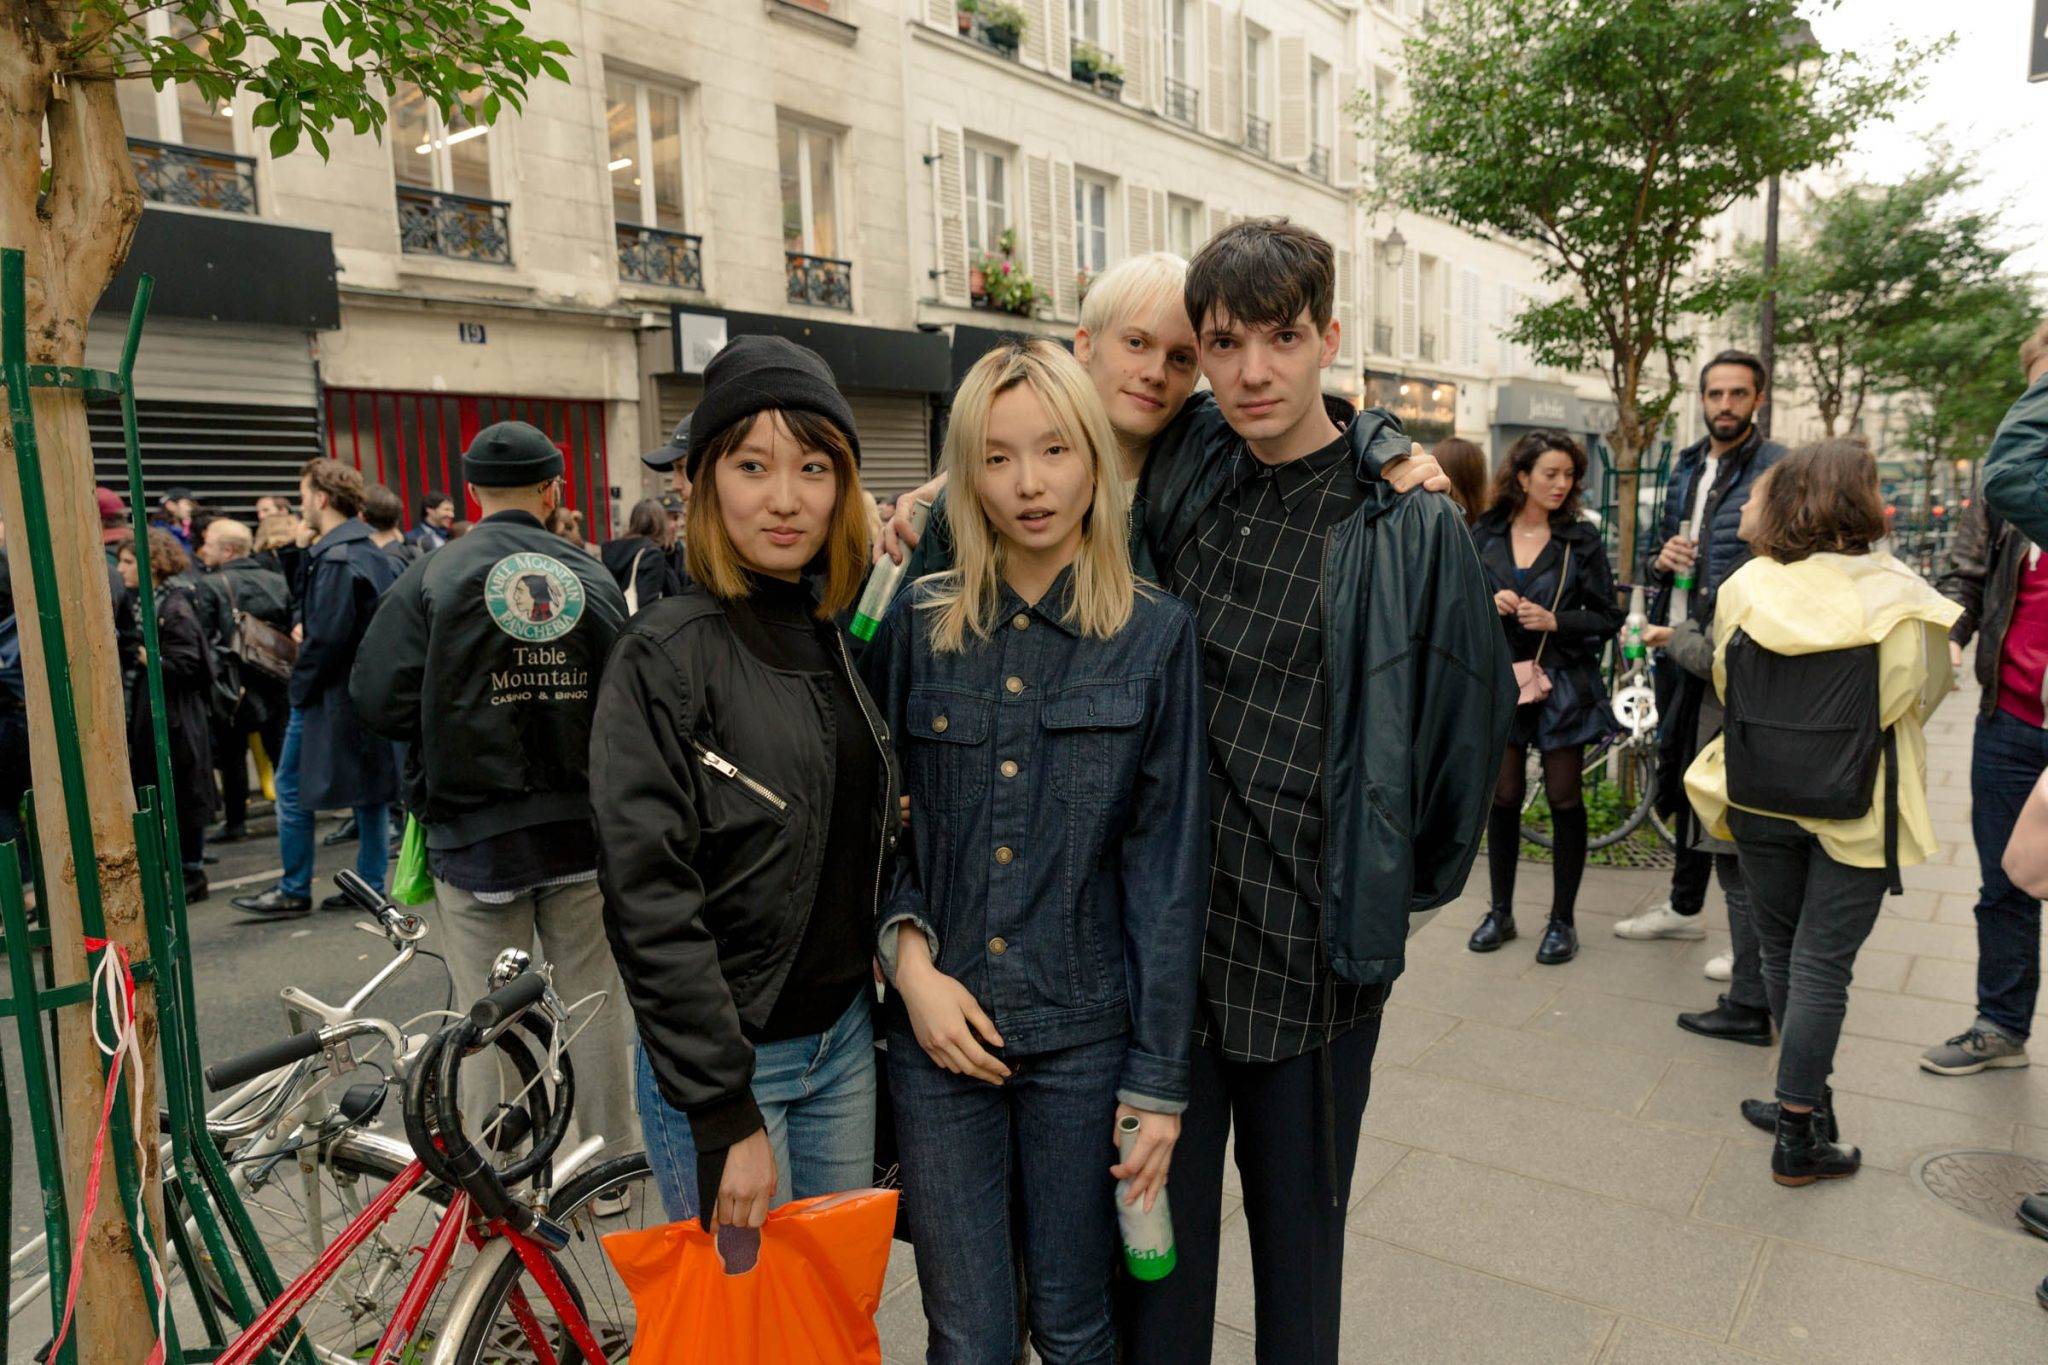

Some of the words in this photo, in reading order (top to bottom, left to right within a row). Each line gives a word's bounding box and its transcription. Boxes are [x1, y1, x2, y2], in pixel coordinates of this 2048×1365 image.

[464, 323, 482, 342] 19
[489, 561, 513, 599] TABLE
[515, 555, 580, 601] MOUNTAIN
[500, 609, 574, 639] RANCHERIA
[513, 647, 567, 666] Table
[491, 668, 588, 691] Mountain
[491, 691, 532, 706] CASINO
[539, 690, 549, 700] &
[555, 690, 588, 700] BINGO
